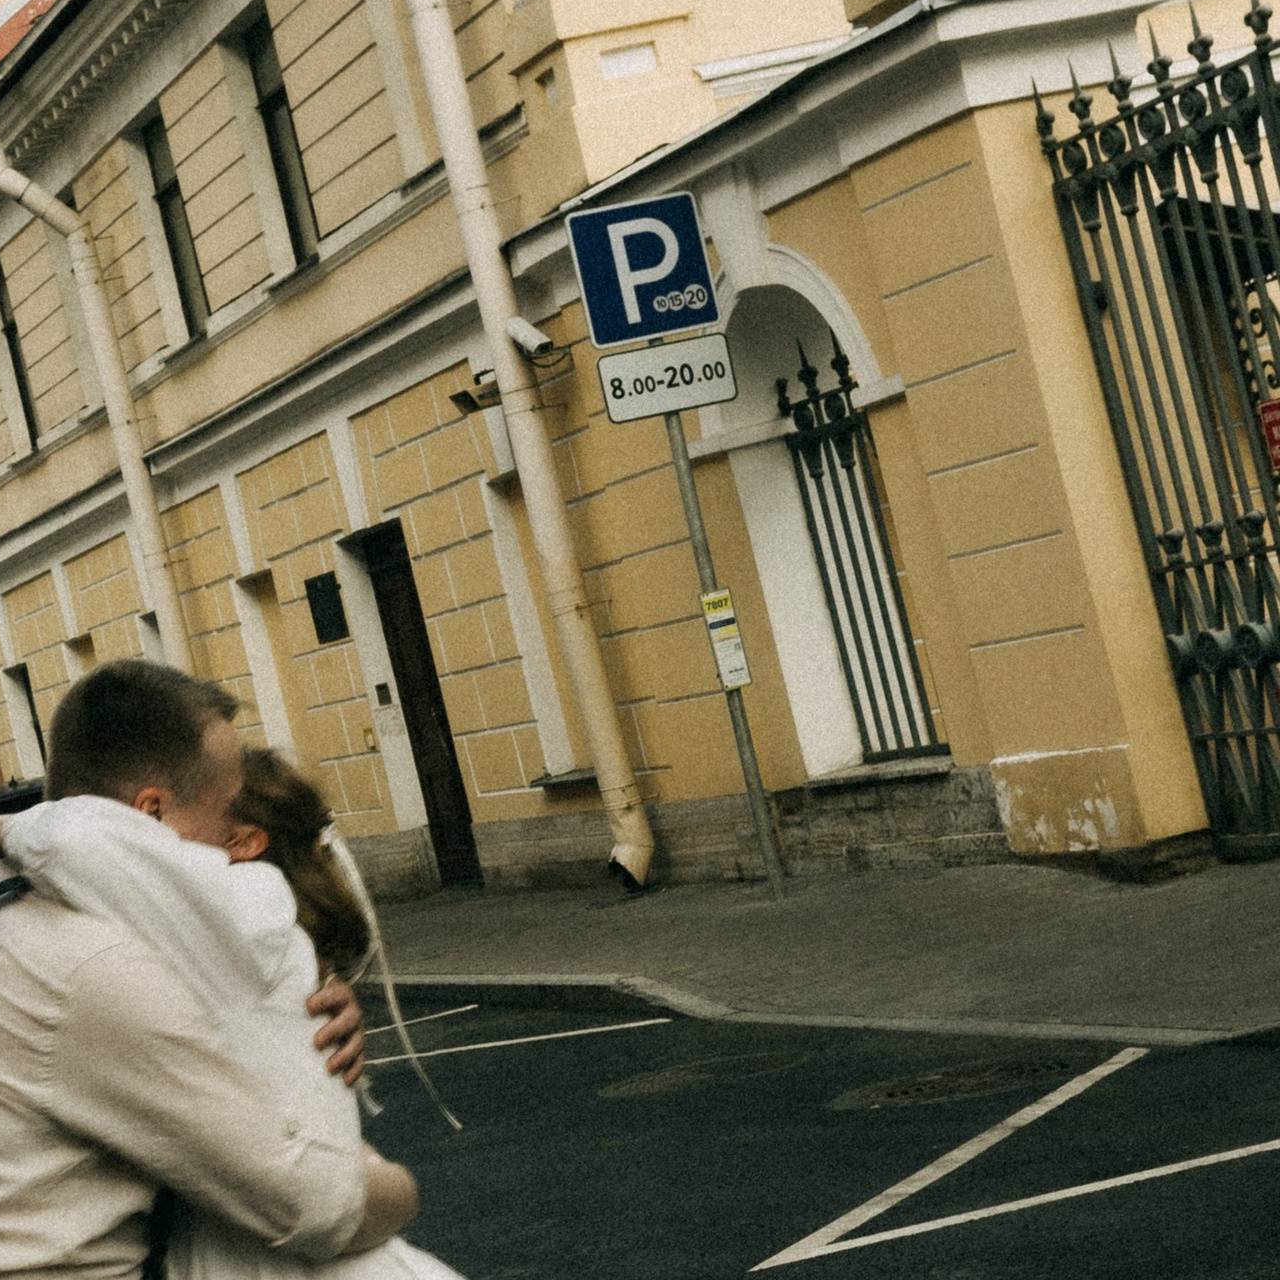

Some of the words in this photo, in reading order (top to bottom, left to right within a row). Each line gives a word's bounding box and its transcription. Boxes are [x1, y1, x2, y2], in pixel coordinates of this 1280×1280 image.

[607, 217, 679, 324] P
[656, 299, 667, 309] 10
[669, 294, 683, 307] 15
[686, 287, 706, 305] 20
[610, 361, 725, 399] 8.00-20.00
[705, 597, 729, 611] 7807
